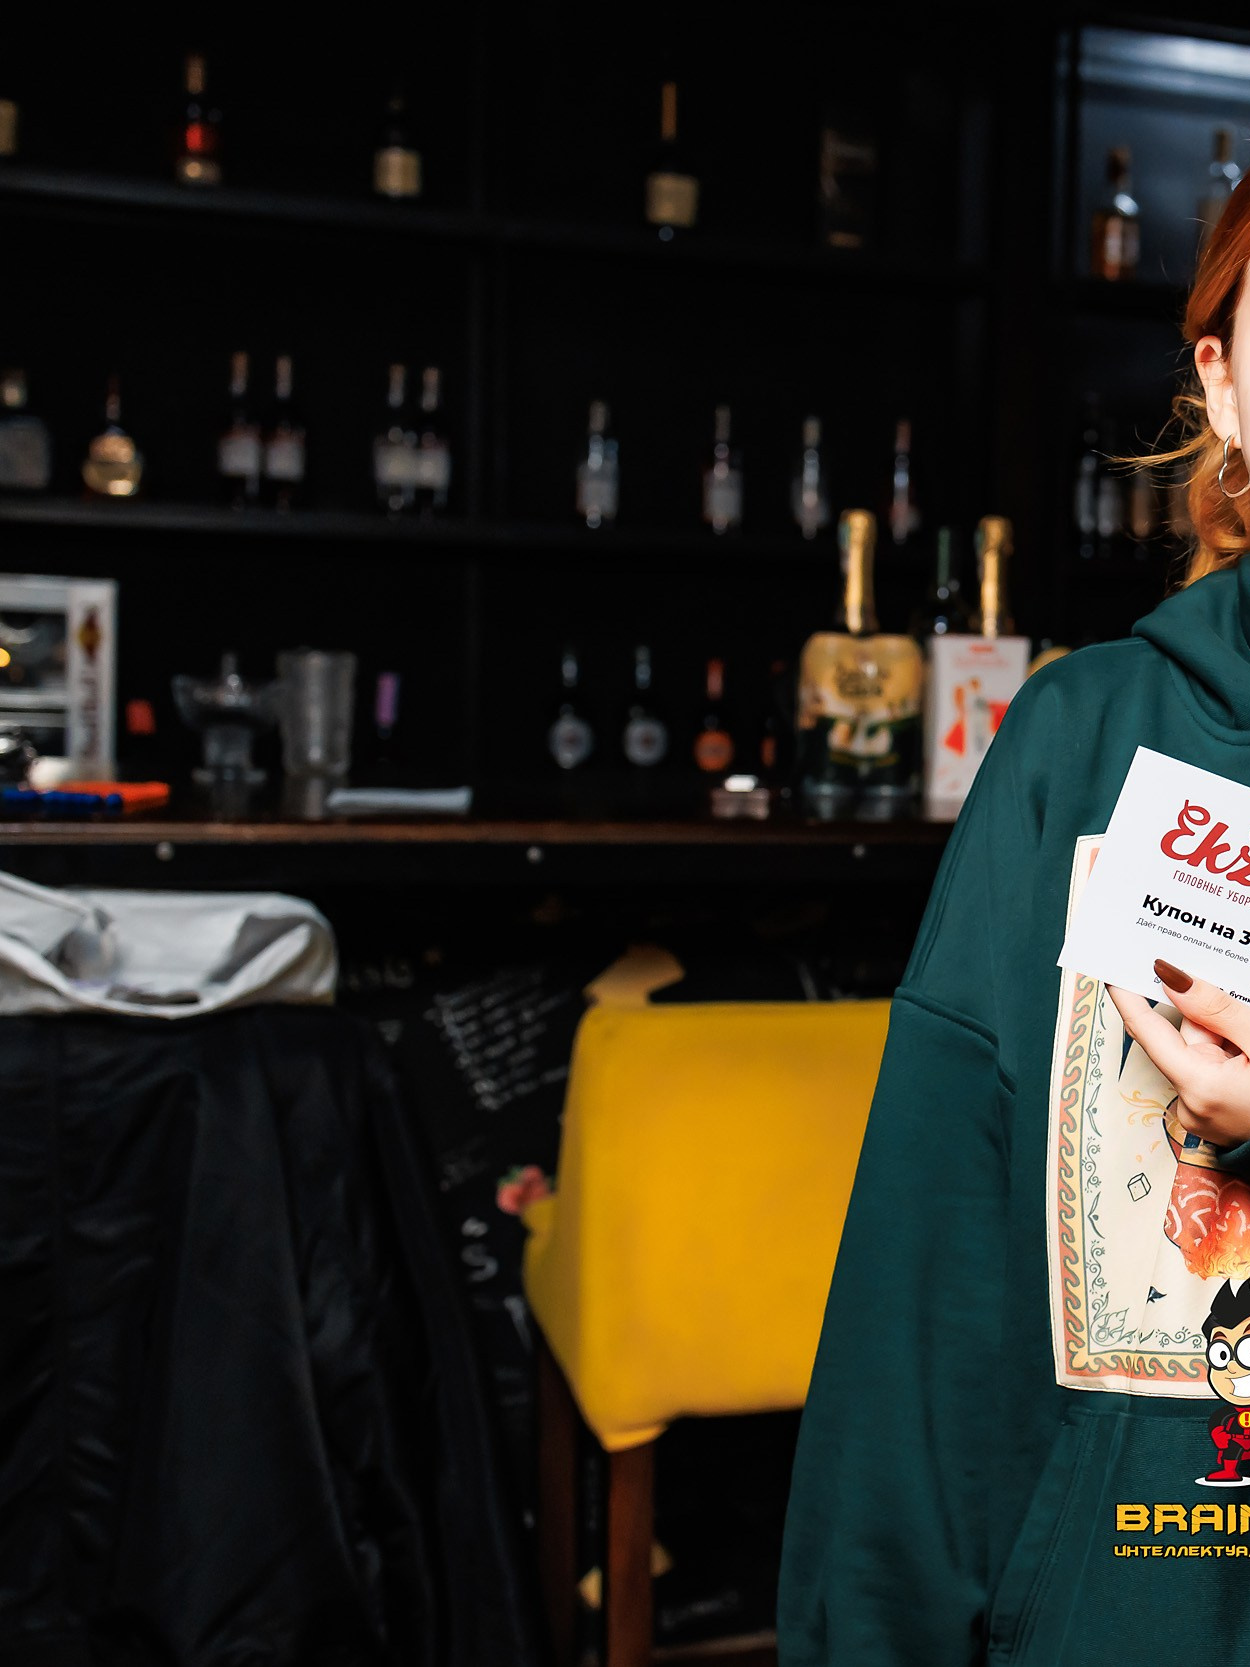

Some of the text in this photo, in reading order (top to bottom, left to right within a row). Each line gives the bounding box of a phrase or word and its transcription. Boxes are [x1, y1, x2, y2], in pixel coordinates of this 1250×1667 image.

[1172, 869, 1224, 897] ГОЛОВНЫЕ
[1142, 894, 1207, 929] Купон
[1209, 921, 1235, 940] на
[1135, 917, 1157, 930] Даёт
[1157, 925, 1182, 939] право
[1182, 935, 1212, 951] оплаты
[1212, 946, 1224, 955] не
[1224, 949, 1249, 964] более
